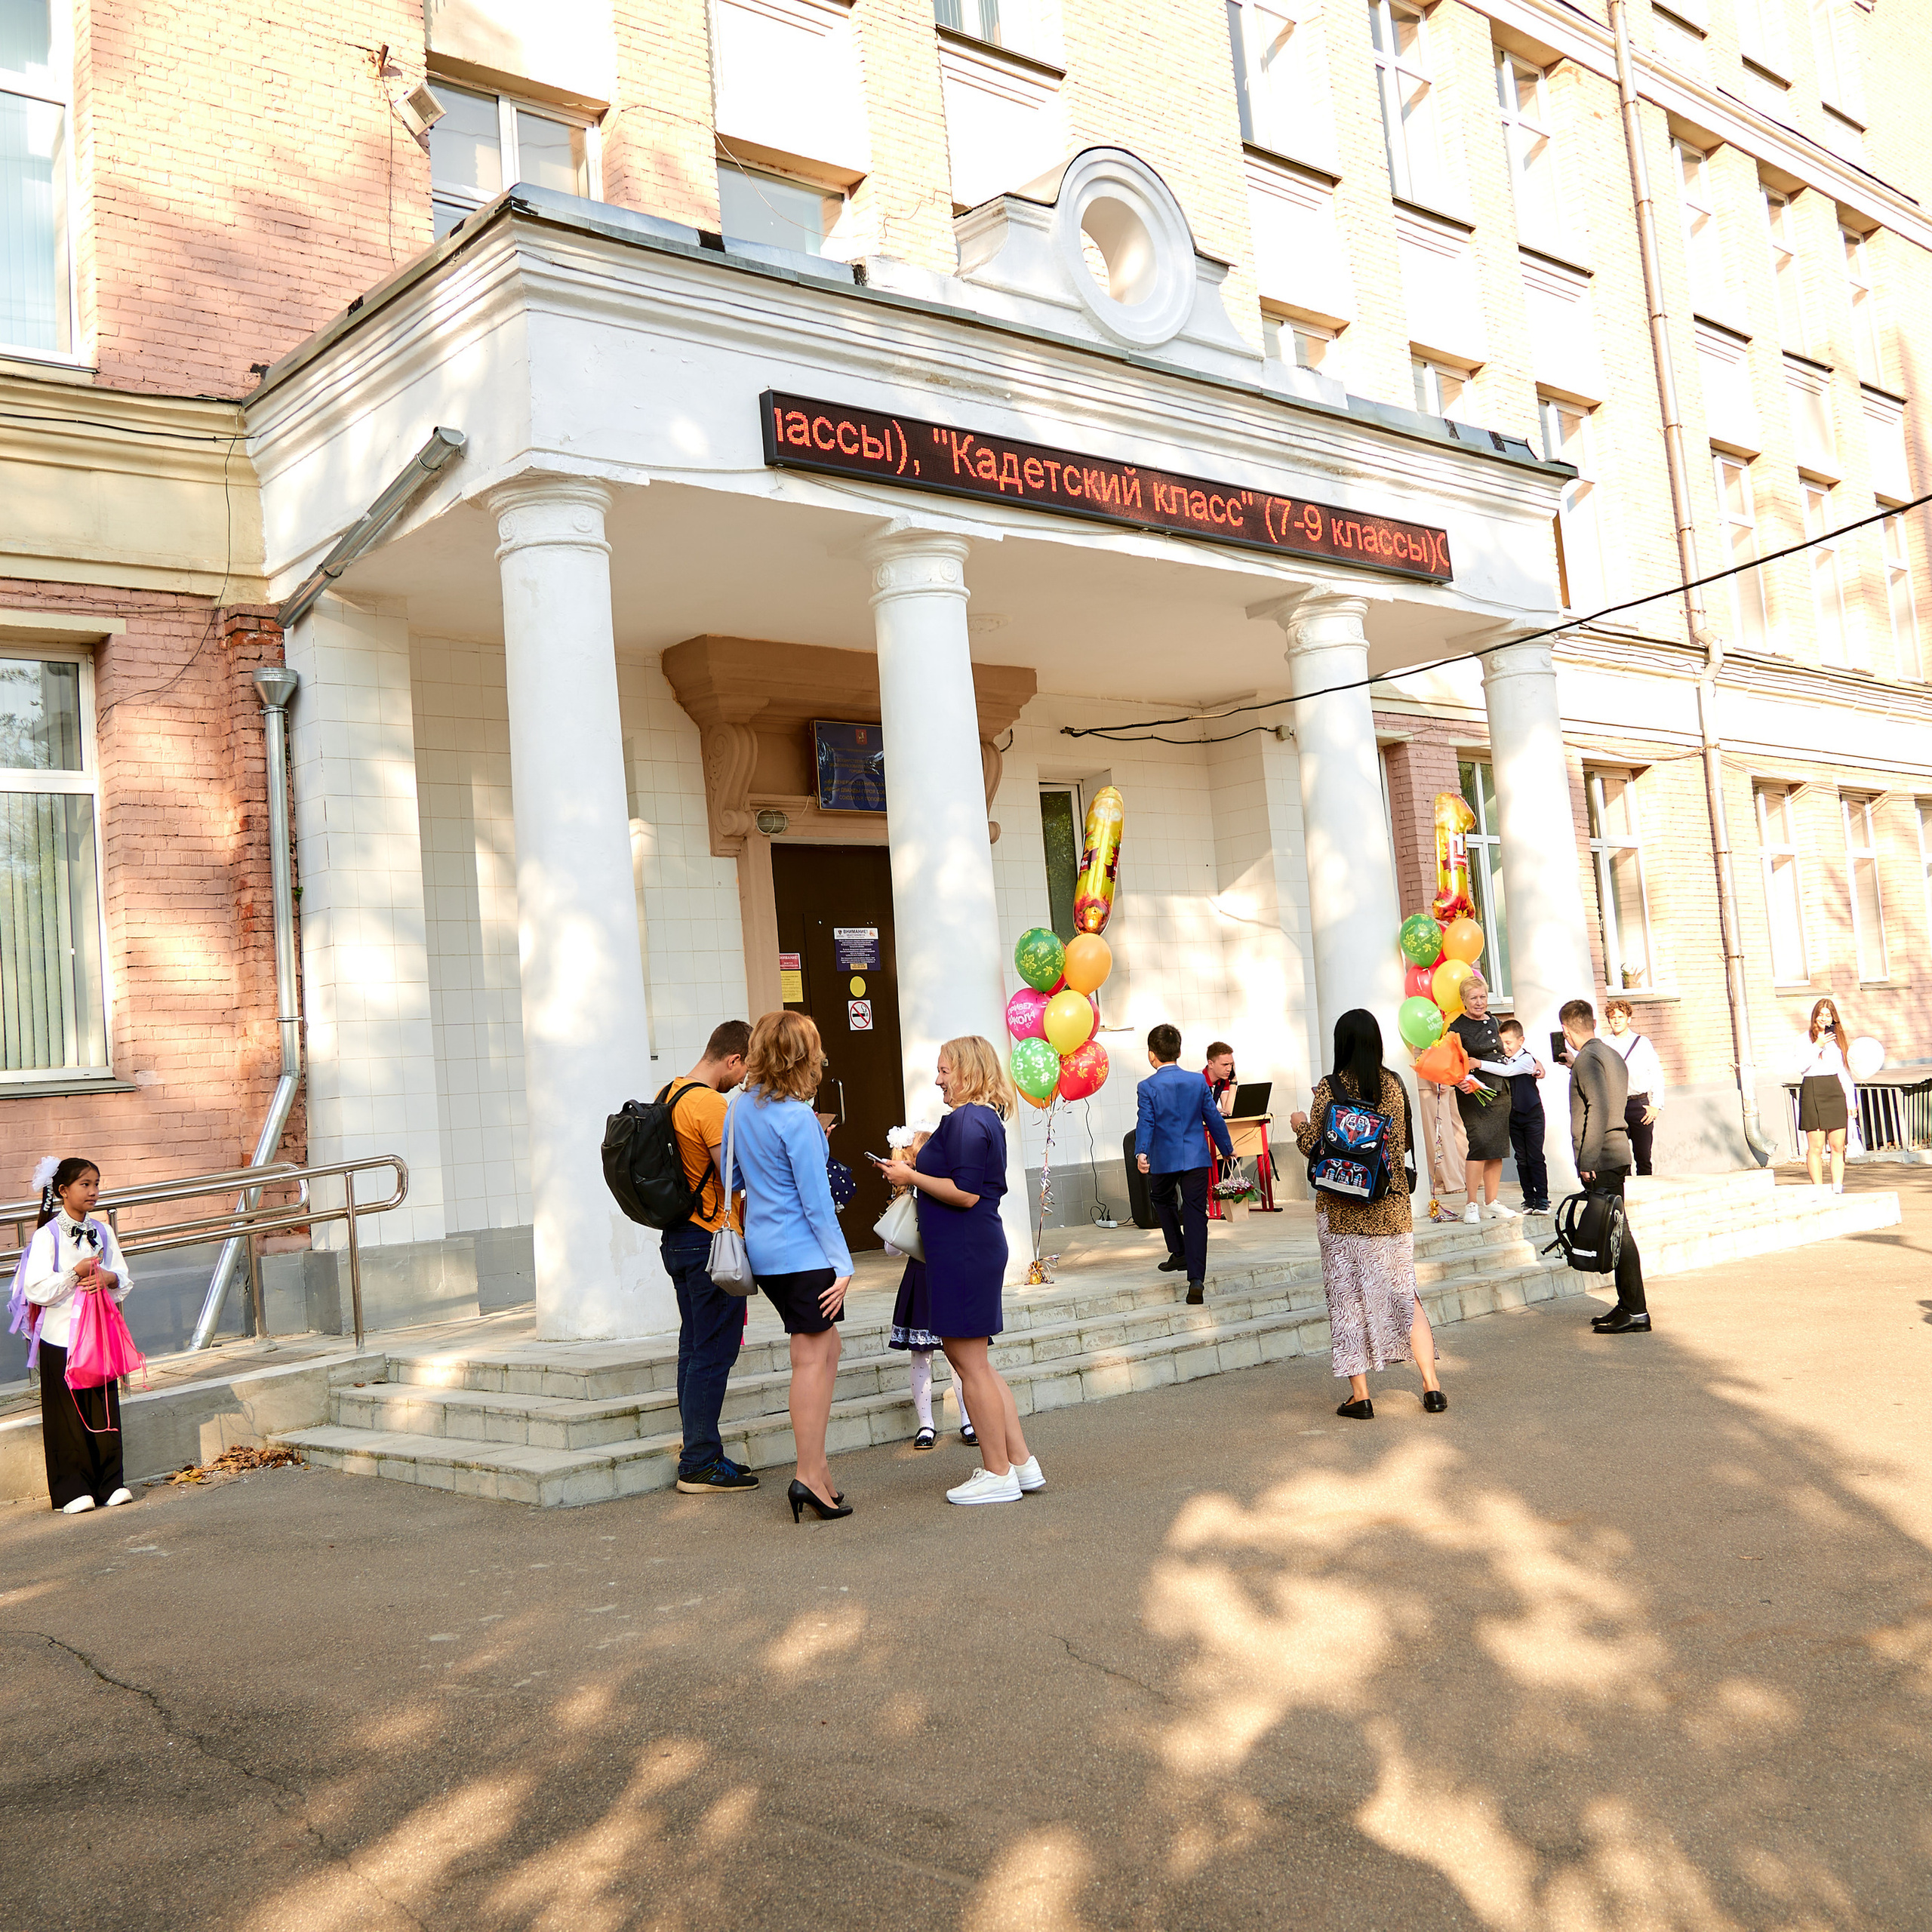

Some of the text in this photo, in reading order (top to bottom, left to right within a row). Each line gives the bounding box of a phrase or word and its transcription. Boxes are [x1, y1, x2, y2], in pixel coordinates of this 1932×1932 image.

[934, 428, 1142, 508] "Кадетский
[1153, 482, 1253, 526] класс"
[1265, 497, 1322, 543] (7-9
[1008, 1010, 1035, 1026] ШКОЛА
[1017, 1056, 1023, 1070] 5
[1035, 1054, 1044, 1069] 3
